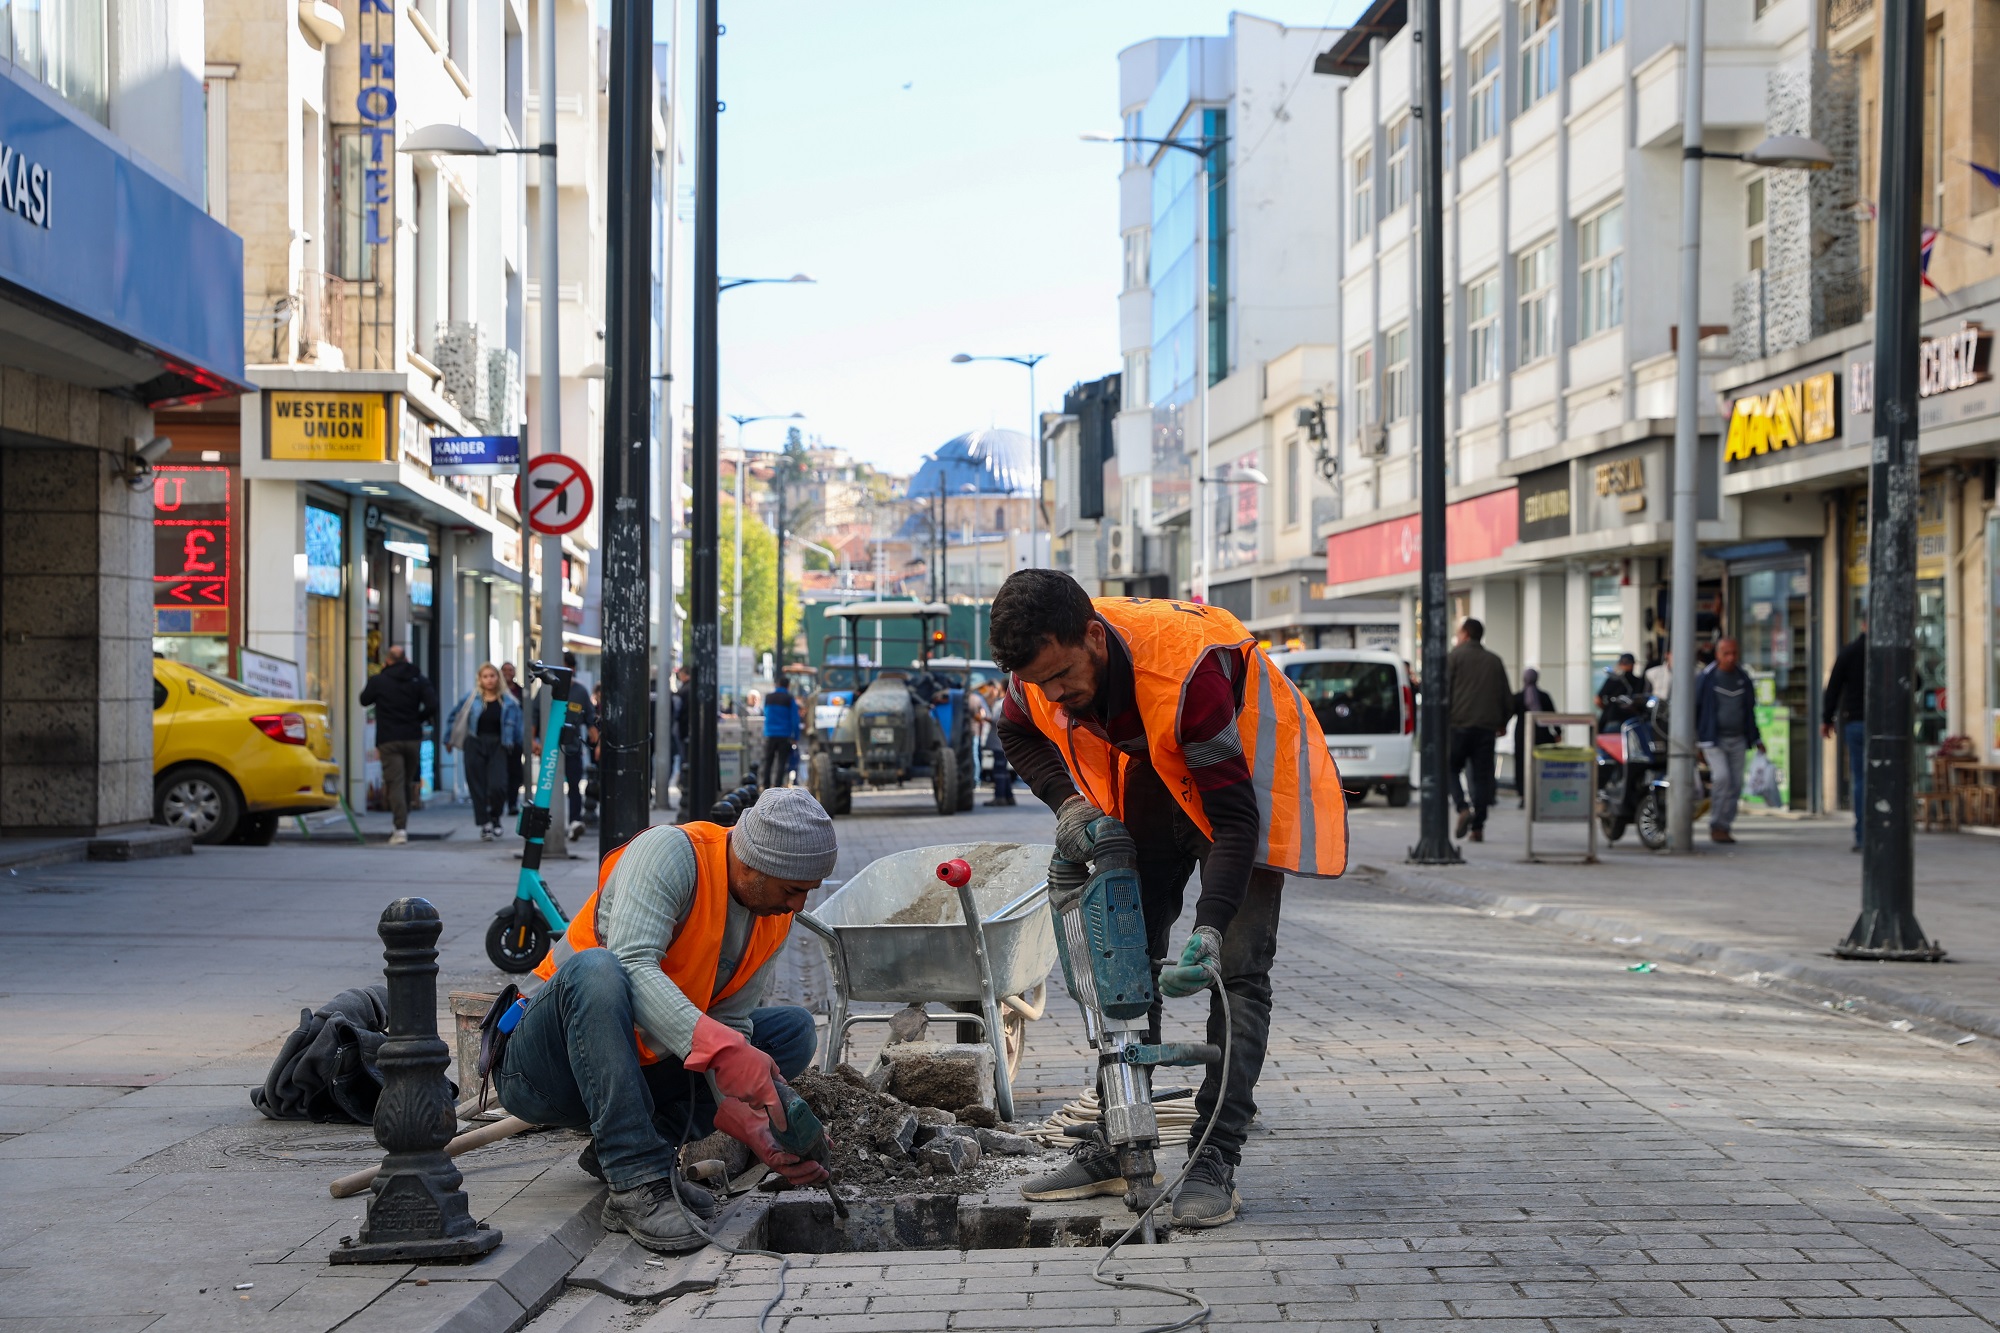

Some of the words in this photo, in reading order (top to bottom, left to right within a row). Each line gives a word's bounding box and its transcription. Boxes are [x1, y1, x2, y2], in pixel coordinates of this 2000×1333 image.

[357, 43, 397, 244] HOTEL
[276, 401, 363, 419] WESTERN
[304, 421, 363, 438] UNION
[434, 441, 486, 454] KANBER
[540, 748, 560, 791] binbin
